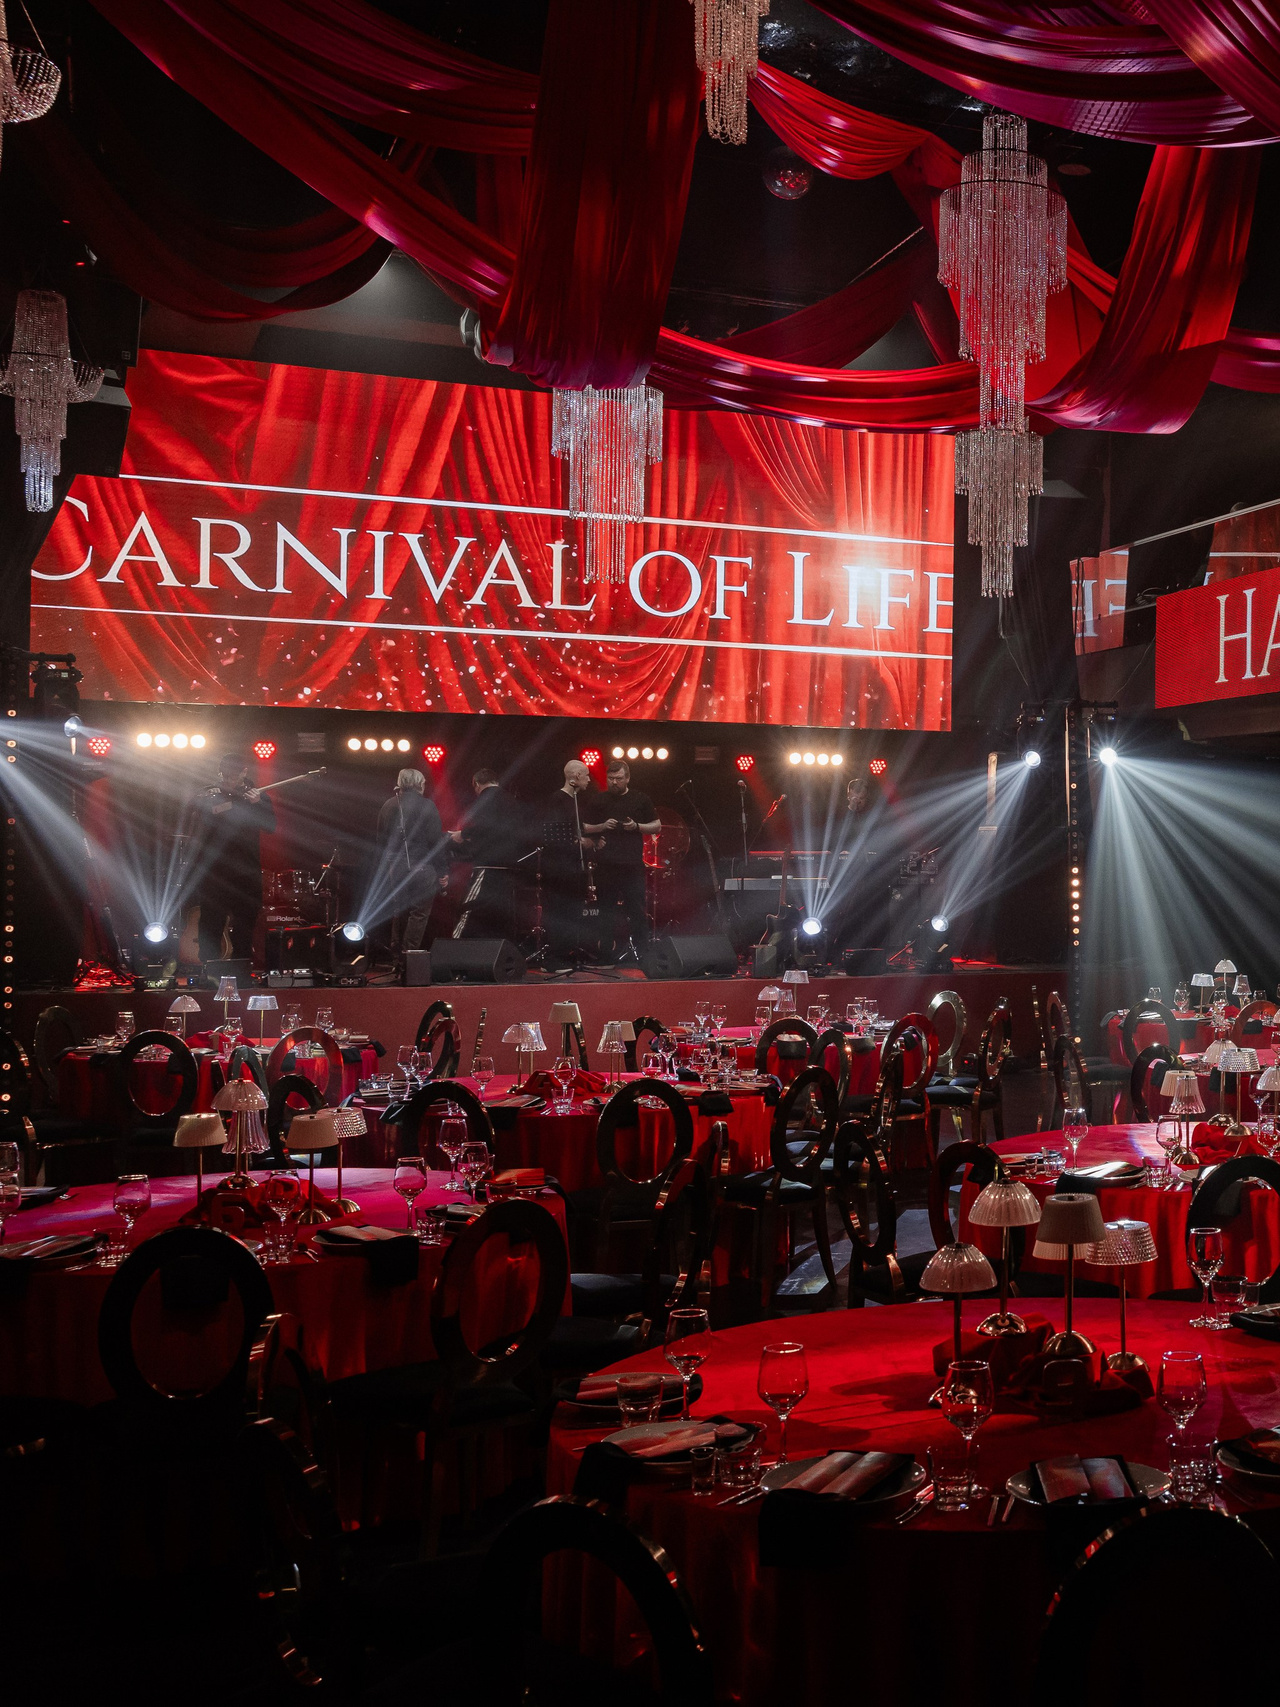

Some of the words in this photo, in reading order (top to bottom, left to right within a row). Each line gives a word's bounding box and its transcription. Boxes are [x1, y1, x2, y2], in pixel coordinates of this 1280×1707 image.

[628, 550, 753, 620] OF
[787, 550, 953, 634] LIFE
[275, 914, 302, 923] Roland
